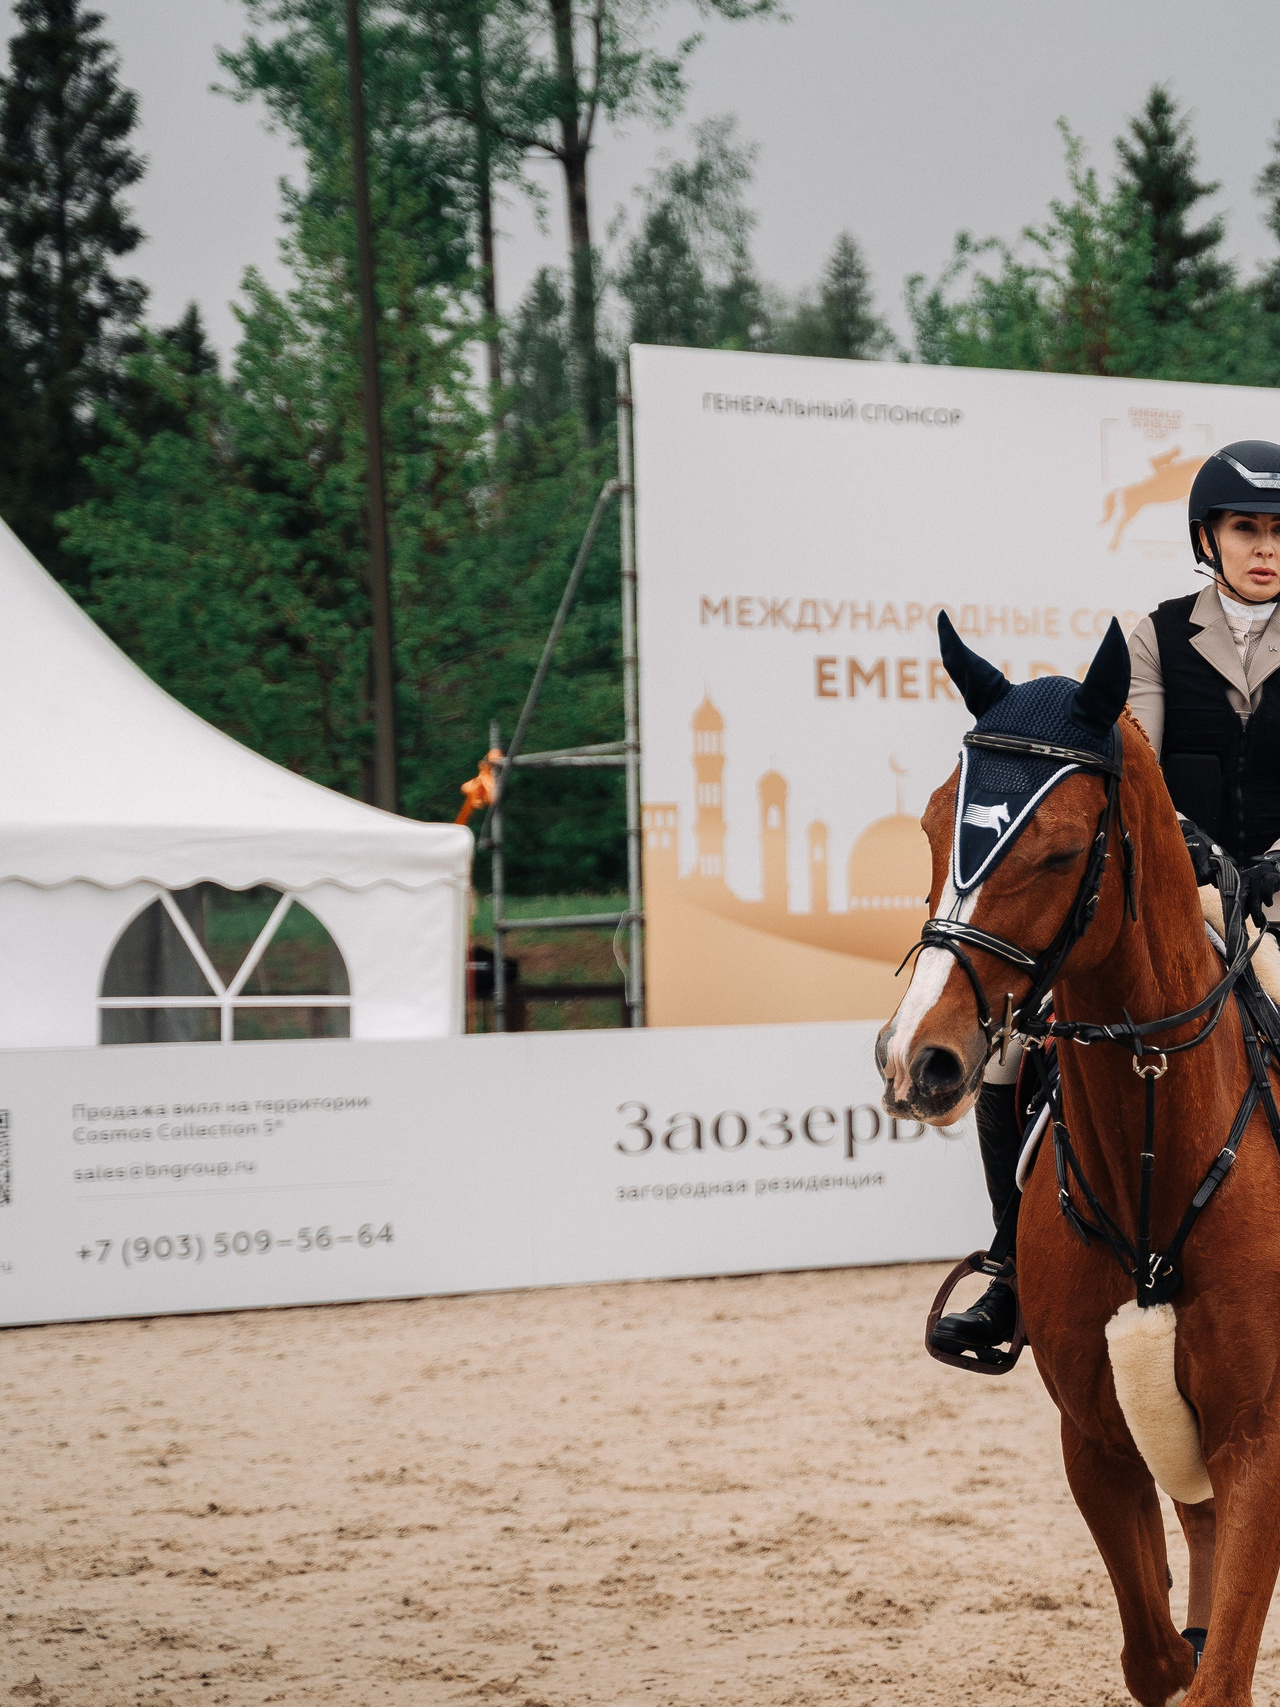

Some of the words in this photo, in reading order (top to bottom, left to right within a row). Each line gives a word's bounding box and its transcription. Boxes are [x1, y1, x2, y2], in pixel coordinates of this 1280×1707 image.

[702, 391, 855, 420] ГЕНЕРАЛЬНЫЙ
[860, 402, 964, 427] СПОНСОР
[700, 595, 1060, 638] МЕЖДУНАРОДНЫЕ
[72, 1103, 168, 1122] Продажа
[172, 1102, 221, 1116] вилл
[226, 1101, 249, 1114] на
[255, 1096, 371, 1116] территории
[72, 1127, 152, 1145] Cosmos
[157, 1122, 257, 1141] Collection
[73, 1162, 256, 1183] sales@bngroup.ru
[615, 1179, 747, 1203] загородная
[755, 1171, 886, 1198] резиденция
[76, 1238, 112, 1263] +7
[121, 1234, 205, 1268] (903)
